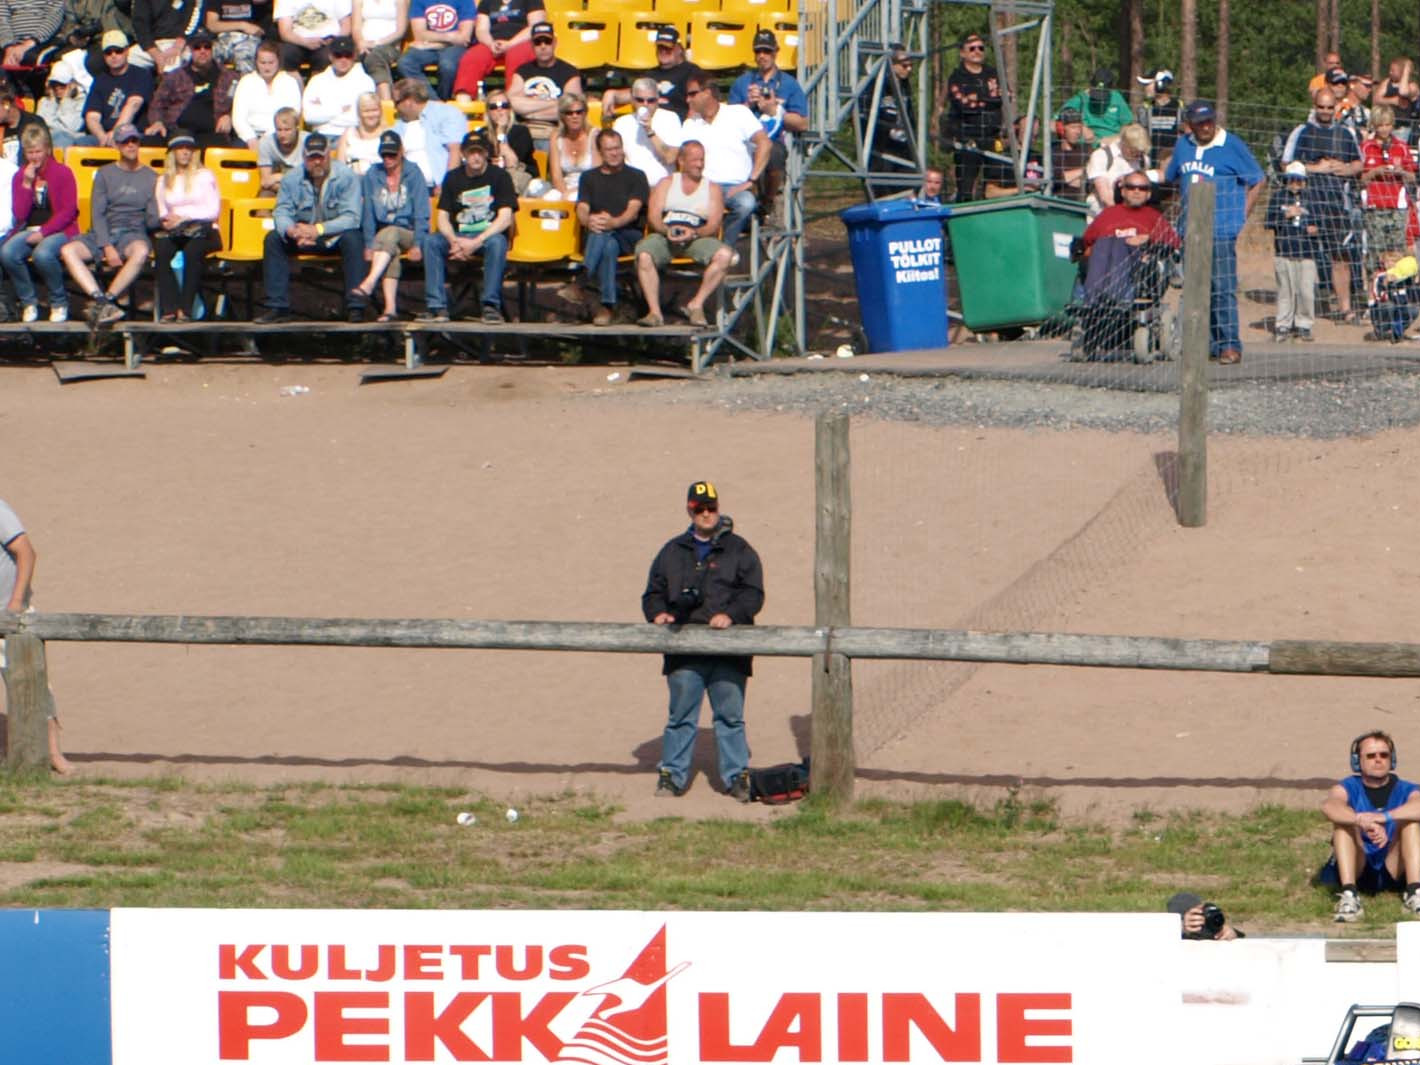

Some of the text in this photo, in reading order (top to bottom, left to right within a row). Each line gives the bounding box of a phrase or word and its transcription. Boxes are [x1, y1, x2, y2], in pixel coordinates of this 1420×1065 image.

[1180, 160, 1216, 178] ITALIA
[888, 238, 942, 255] PULLOT
[896, 267, 940, 284] Kiitos!
[219, 944, 590, 982] KULJETUS
[698, 992, 1073, 1063] LAINE
